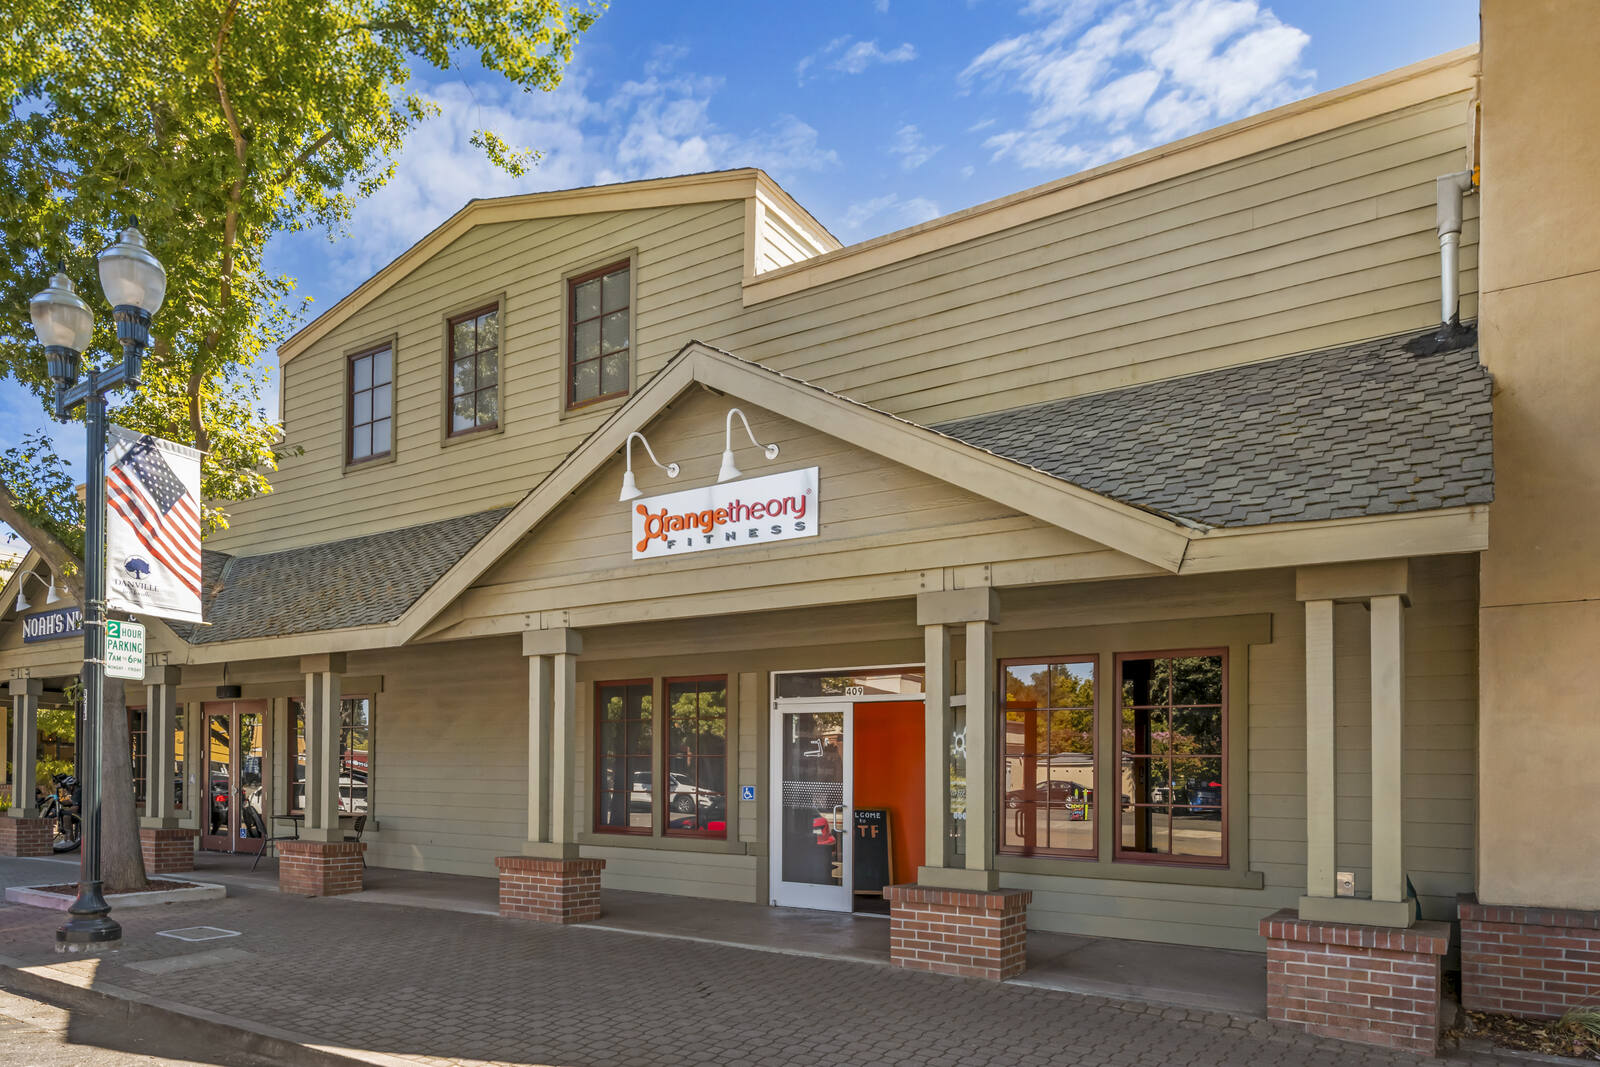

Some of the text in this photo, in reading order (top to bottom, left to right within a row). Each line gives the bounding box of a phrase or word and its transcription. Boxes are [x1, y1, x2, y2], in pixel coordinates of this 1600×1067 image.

[667, 521, 806, 549] FITNESS
[22, 613, 64, 638] NOAH'S
[108, 623, 142, 638] 2 HOUR
[107, 639, 143, 654] PARKING
[108, 652, 121, 662] 7AM
[128, 655, 142, 664] 6PM
[846, 687, 863, 696] 409
